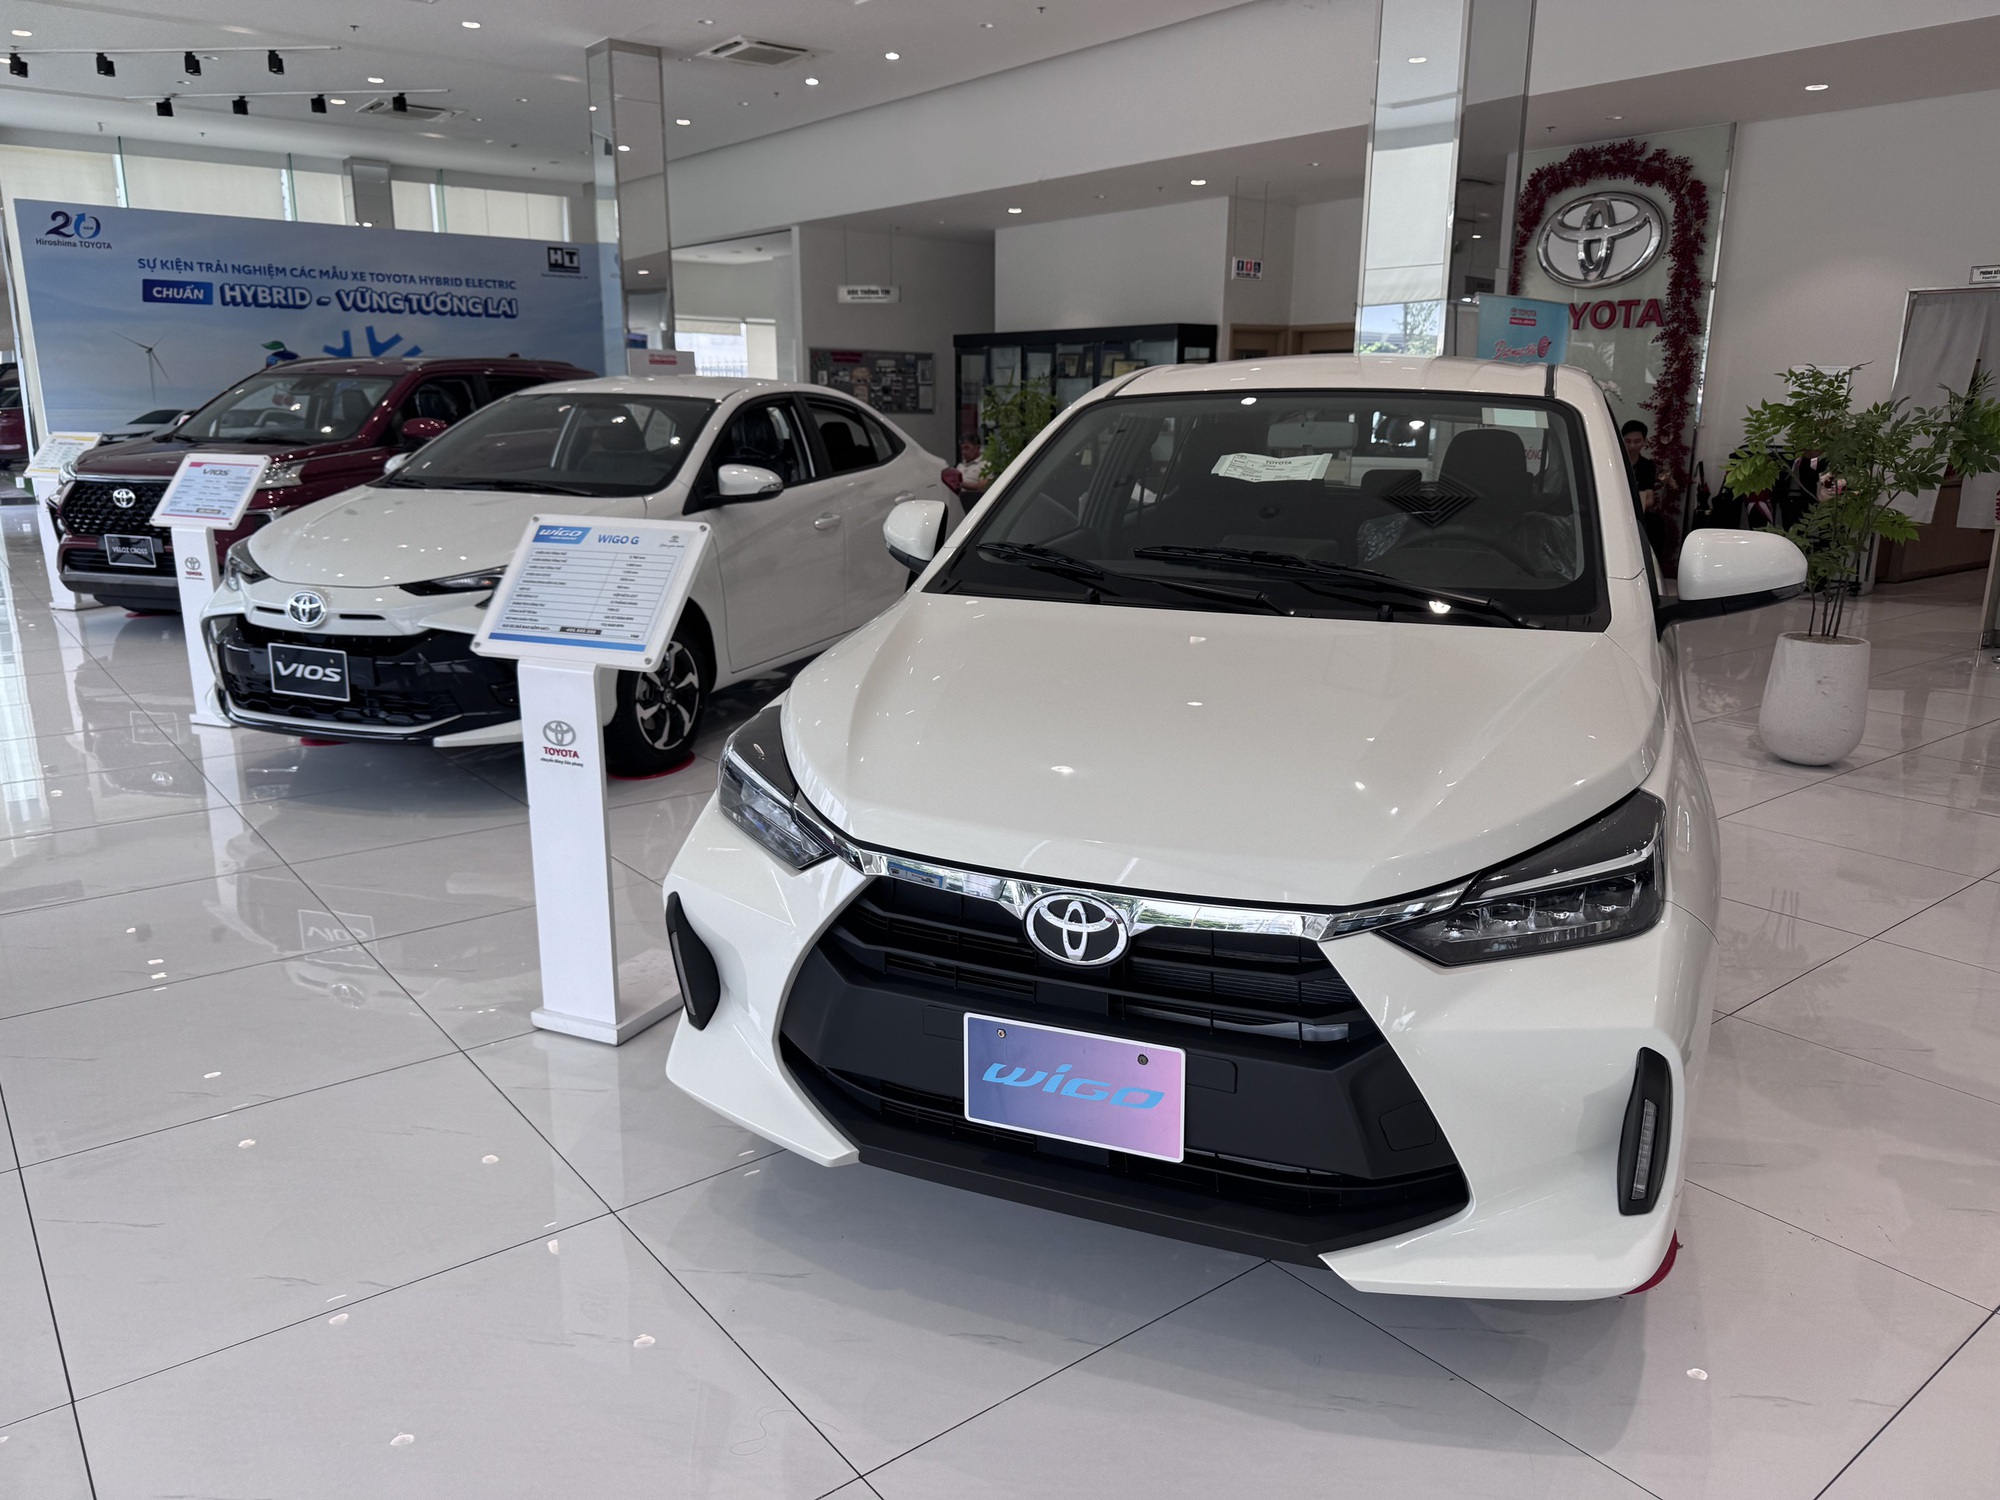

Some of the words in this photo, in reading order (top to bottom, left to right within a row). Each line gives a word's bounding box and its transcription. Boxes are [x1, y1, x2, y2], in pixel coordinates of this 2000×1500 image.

[35, 238, 77, 247] Hiroshima
[79, 241, 113, 249] TOYOTA
[137, 257, 157, 273] SỰ
[160, 258, 194, 274] KIỆN
[197, 259, 229, 274] TRẢI
[231, 264, 287, 279] NGHIỆM
[290, 265, 316, 280] CÁC
[350, 271, 367, 282] XE
[369, 272, 417, 285] TOYOTA
[419, 275, 463, 287] HYBRID
[465, 278, 517, 290] ELECTRIC
[221, 283, 312, 308] HYBRID
[337, 286, 406, 314] VỮNG
[406, 291, 484, 317] TƯƠNG
[485, 298, 518, 318] LAI
[1568, 299, 1666, 330] YOTA
[202, 468, 230, 476] VIOS
[598, 534, 629, 544] WIGO
[631, 536, 640, 545] G
[275, 661, 342, 682] VIOS
[543, 746, 579, 758] TOYOTA
